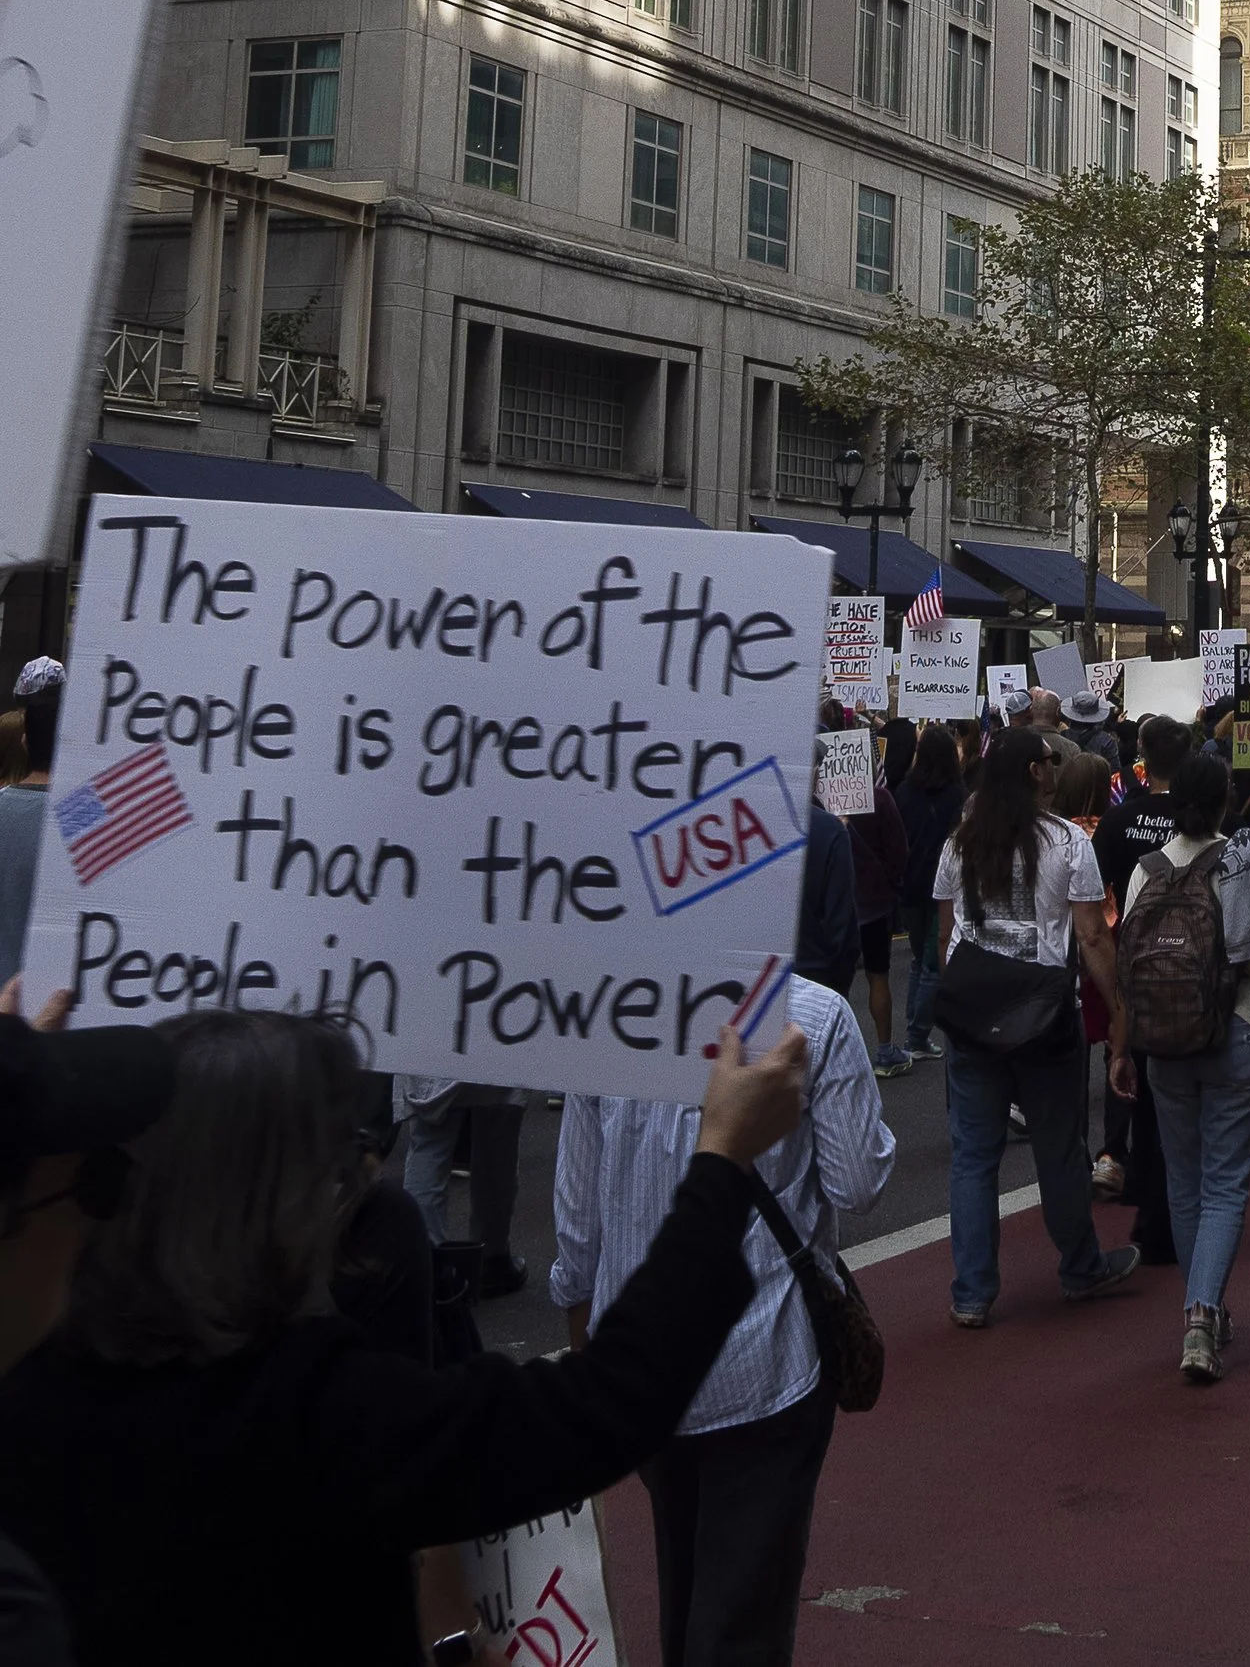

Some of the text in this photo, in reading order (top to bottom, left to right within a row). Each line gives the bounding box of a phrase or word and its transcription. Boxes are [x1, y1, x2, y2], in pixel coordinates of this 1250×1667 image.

[102, 516, 255, 625] The
[541, 557, 642, 668] of
[641, 572, 801, 695] the
[848, 603, 881, 621] HATE,
[909, 629, 963, 644] THIS IS
[1201, 632, 1219, 645] NO
[829, 646, 878, 659] CRUELTY!
[1202, 647, 1235, 657] BALLRO
[830, 661, 872, 675] TRUMP!
[1204, 660, 1217, 671] NO
[904, 681, 970, 694] EMBARRASSING
[1204, 674, 1215, 685] NO
[1203, 688, 1220, 702] NO
[97, 656, 744, 800] People is greater
[826, 735, 865, 758] efend
[1237, 743, 1248, 754] TO
[818, 755, 870, 778] EMOCRACY
[829, 776, 867, 794] KINGS!
[828, 792, 868, 812] NAZIS!
[1136, 814, 1175, 828] I believ
[1125, 827, 1165, 844] Philly's
[651, 797, 776, 891] USA
[217, 789, 625, 924] than the
[70, 911, 278, 1012] People
[313, 934, 397, 1037] in
